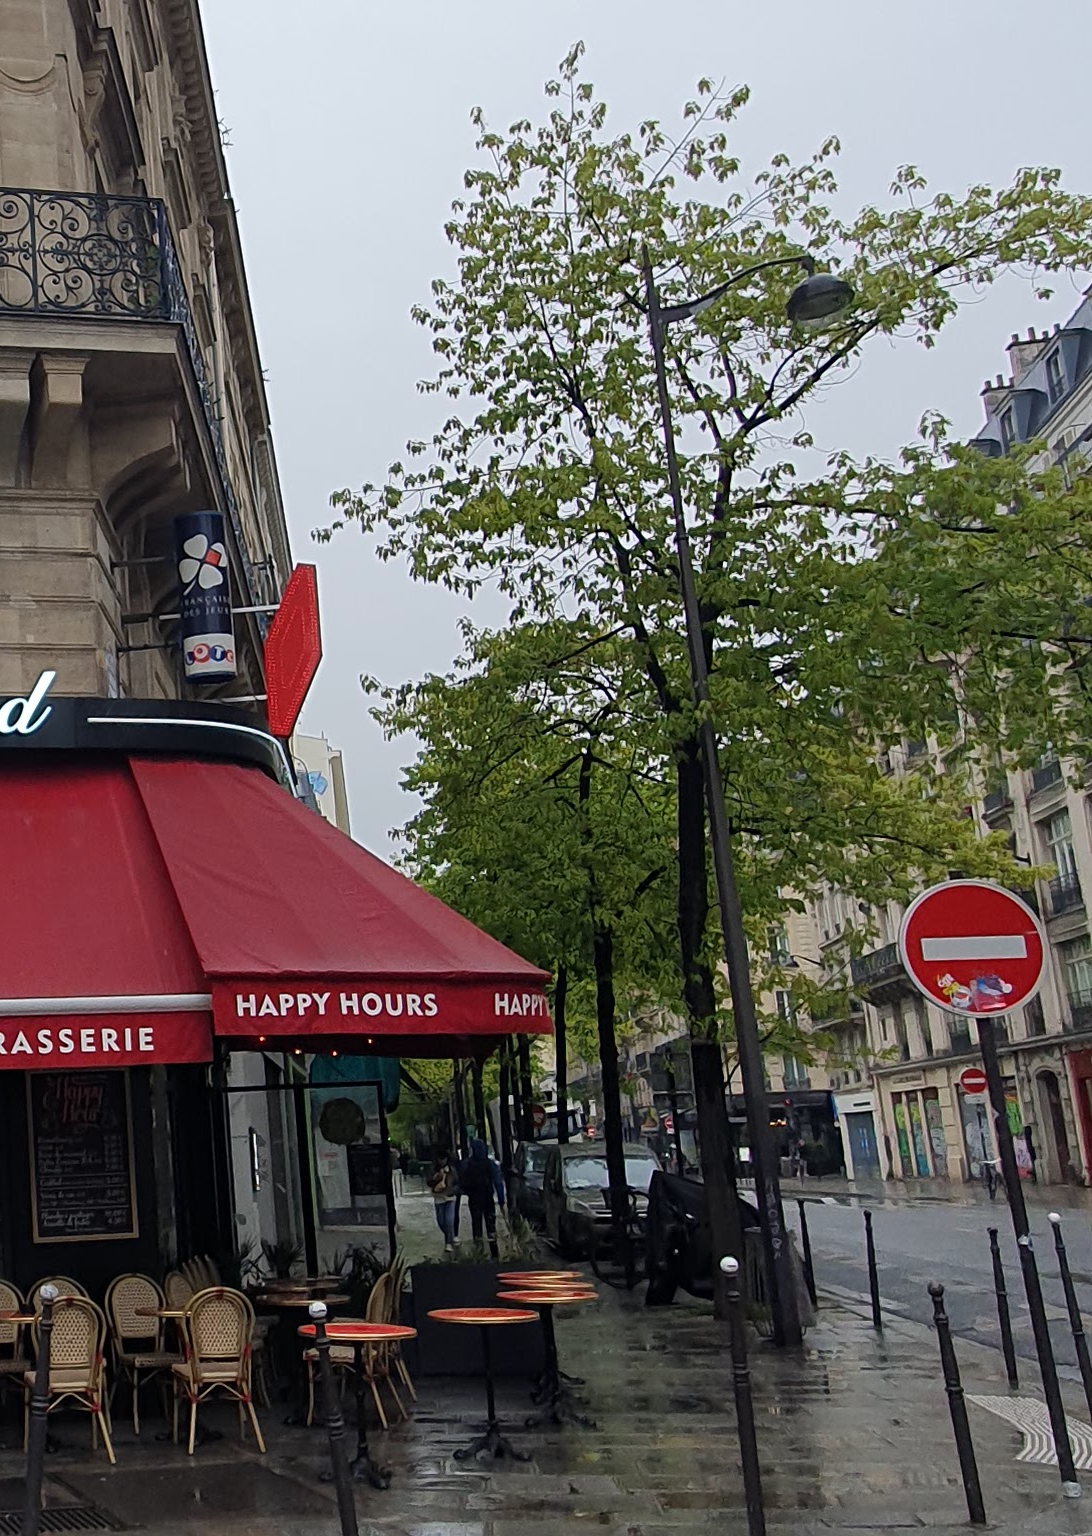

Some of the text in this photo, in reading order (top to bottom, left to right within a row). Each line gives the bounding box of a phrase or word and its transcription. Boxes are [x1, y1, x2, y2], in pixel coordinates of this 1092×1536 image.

[237, 993, 437, 1016] HAPPY HOURS
[495, 993, 544, 1016] HAPPY
